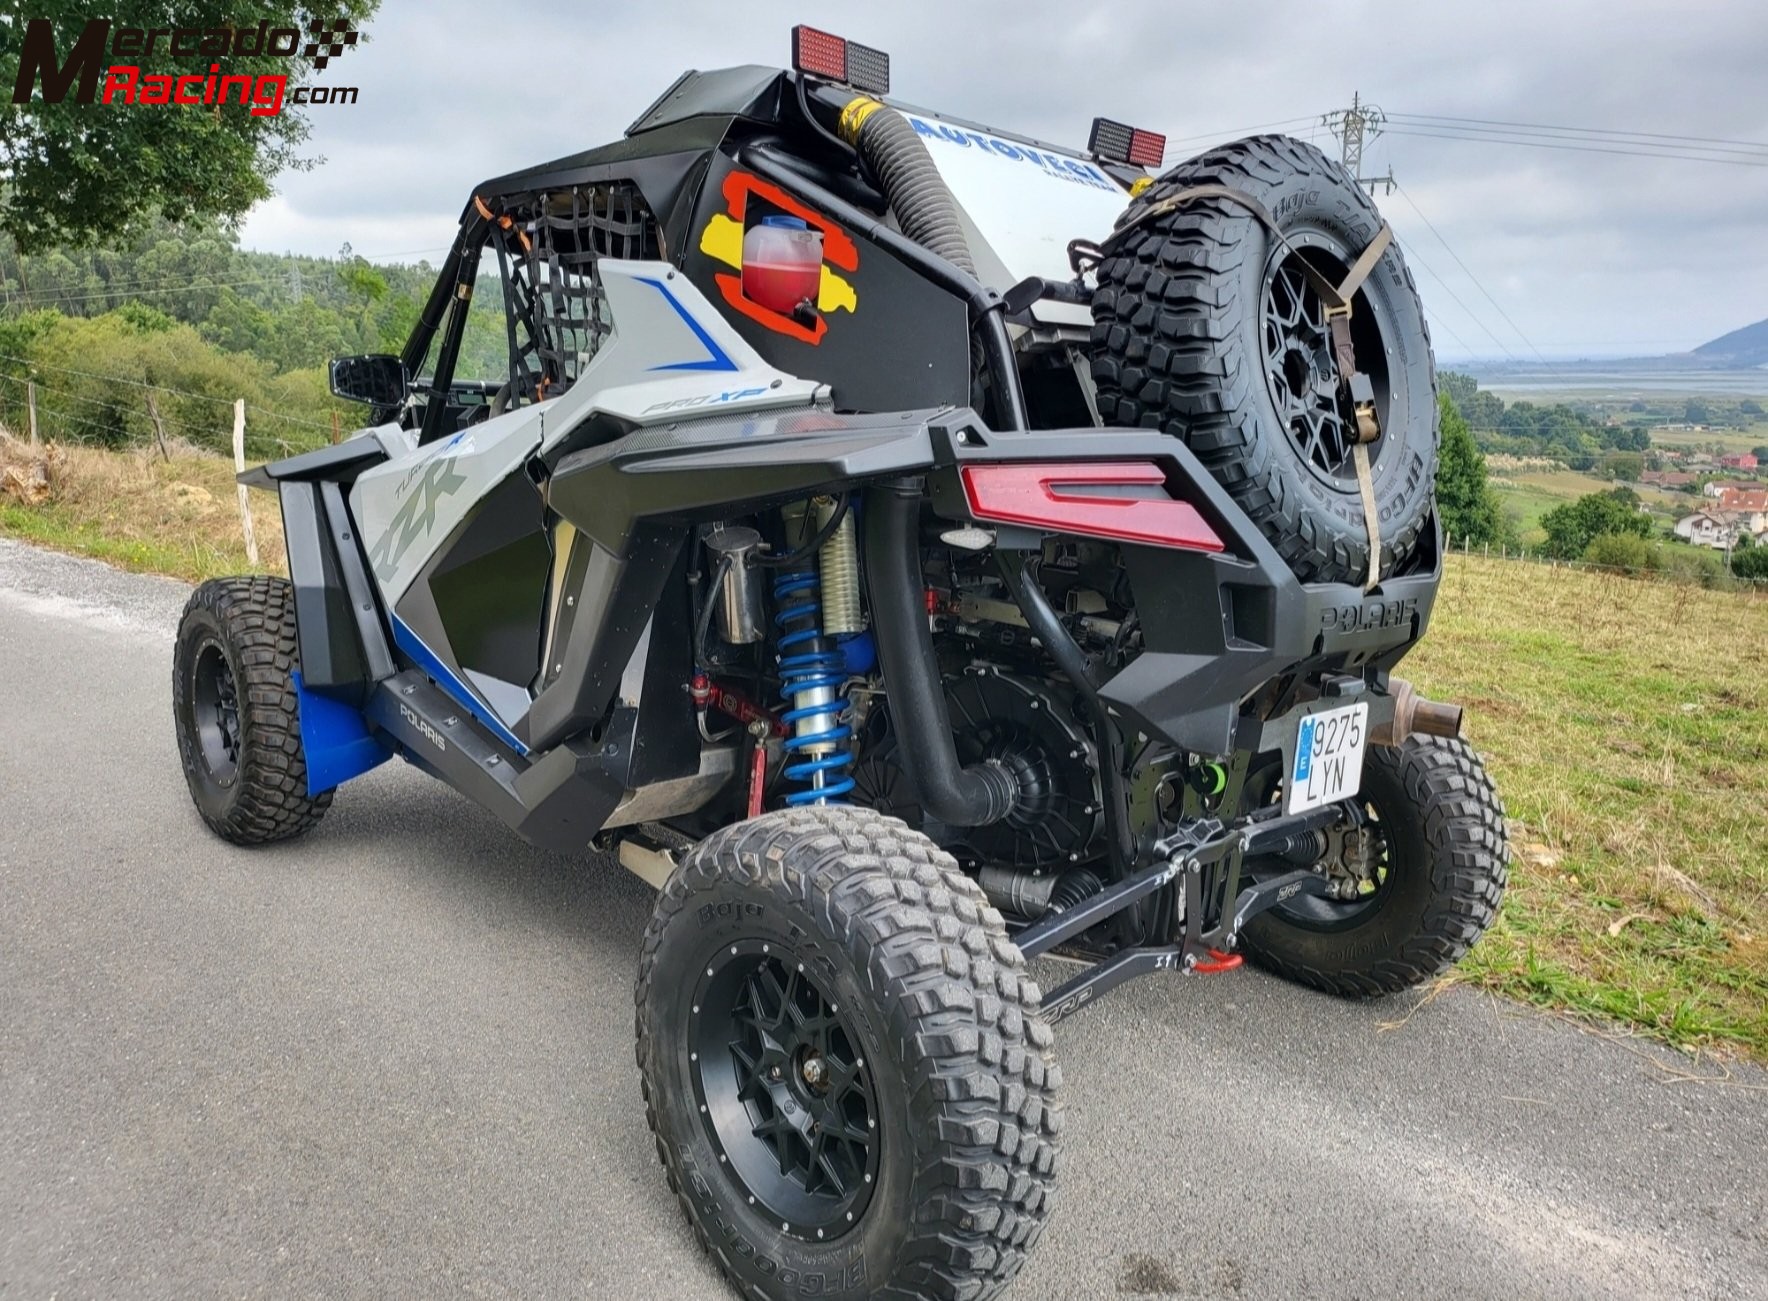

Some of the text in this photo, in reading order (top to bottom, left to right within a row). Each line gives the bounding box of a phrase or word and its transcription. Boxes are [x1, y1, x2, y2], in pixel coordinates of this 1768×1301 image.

[640, 394, 712, 415] PRO
[1293, 451, 1424, 528] BFGodrich
[368, 455, 468, 584] RZR
[1319, 598, 1420, 636] POLARIS
[400, 703, 446, 751] POLARIS
[1313, 711, 1361, 758] 9275
[1300, 755, 1346, 801] E LYN
[698, 901, 764, 926] Baja
